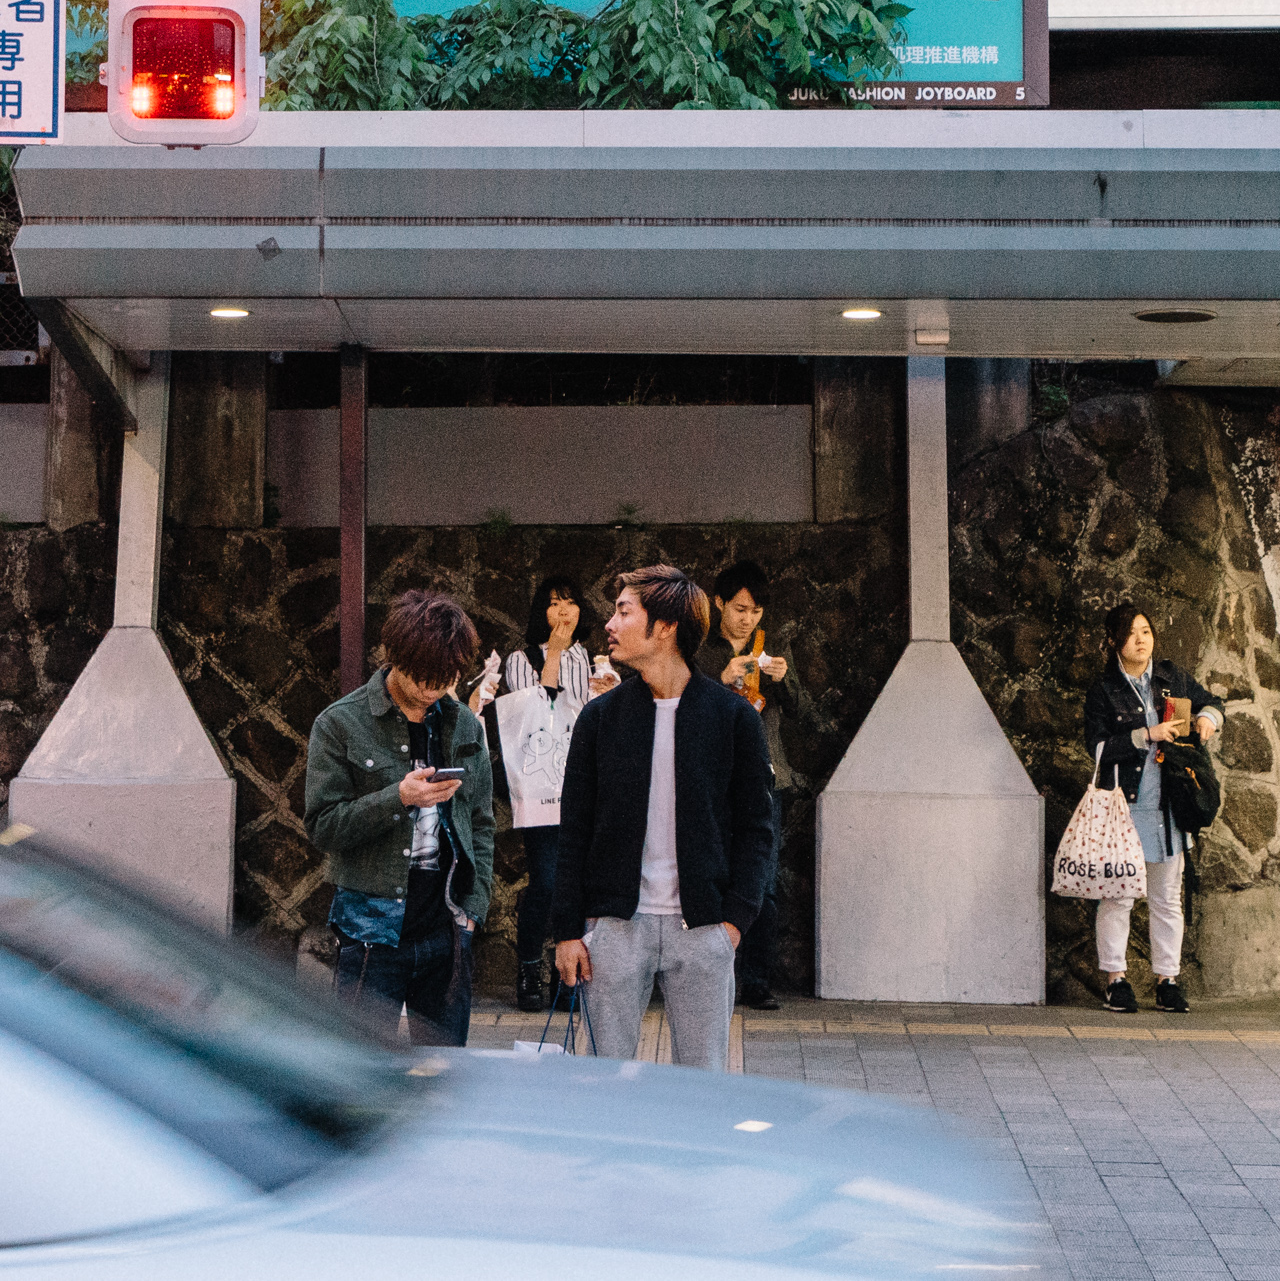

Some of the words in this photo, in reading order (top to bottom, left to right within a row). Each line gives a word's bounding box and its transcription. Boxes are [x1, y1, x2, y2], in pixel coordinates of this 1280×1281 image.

[844, 86, 906, 101] ASHION
[914, 86, 997, 101] JOYBOARD
[1015, 86, 1026, 100] 5
[1058, 857, 1097, 879] ROSE
[1104, 862, 1137, 879] BUD
